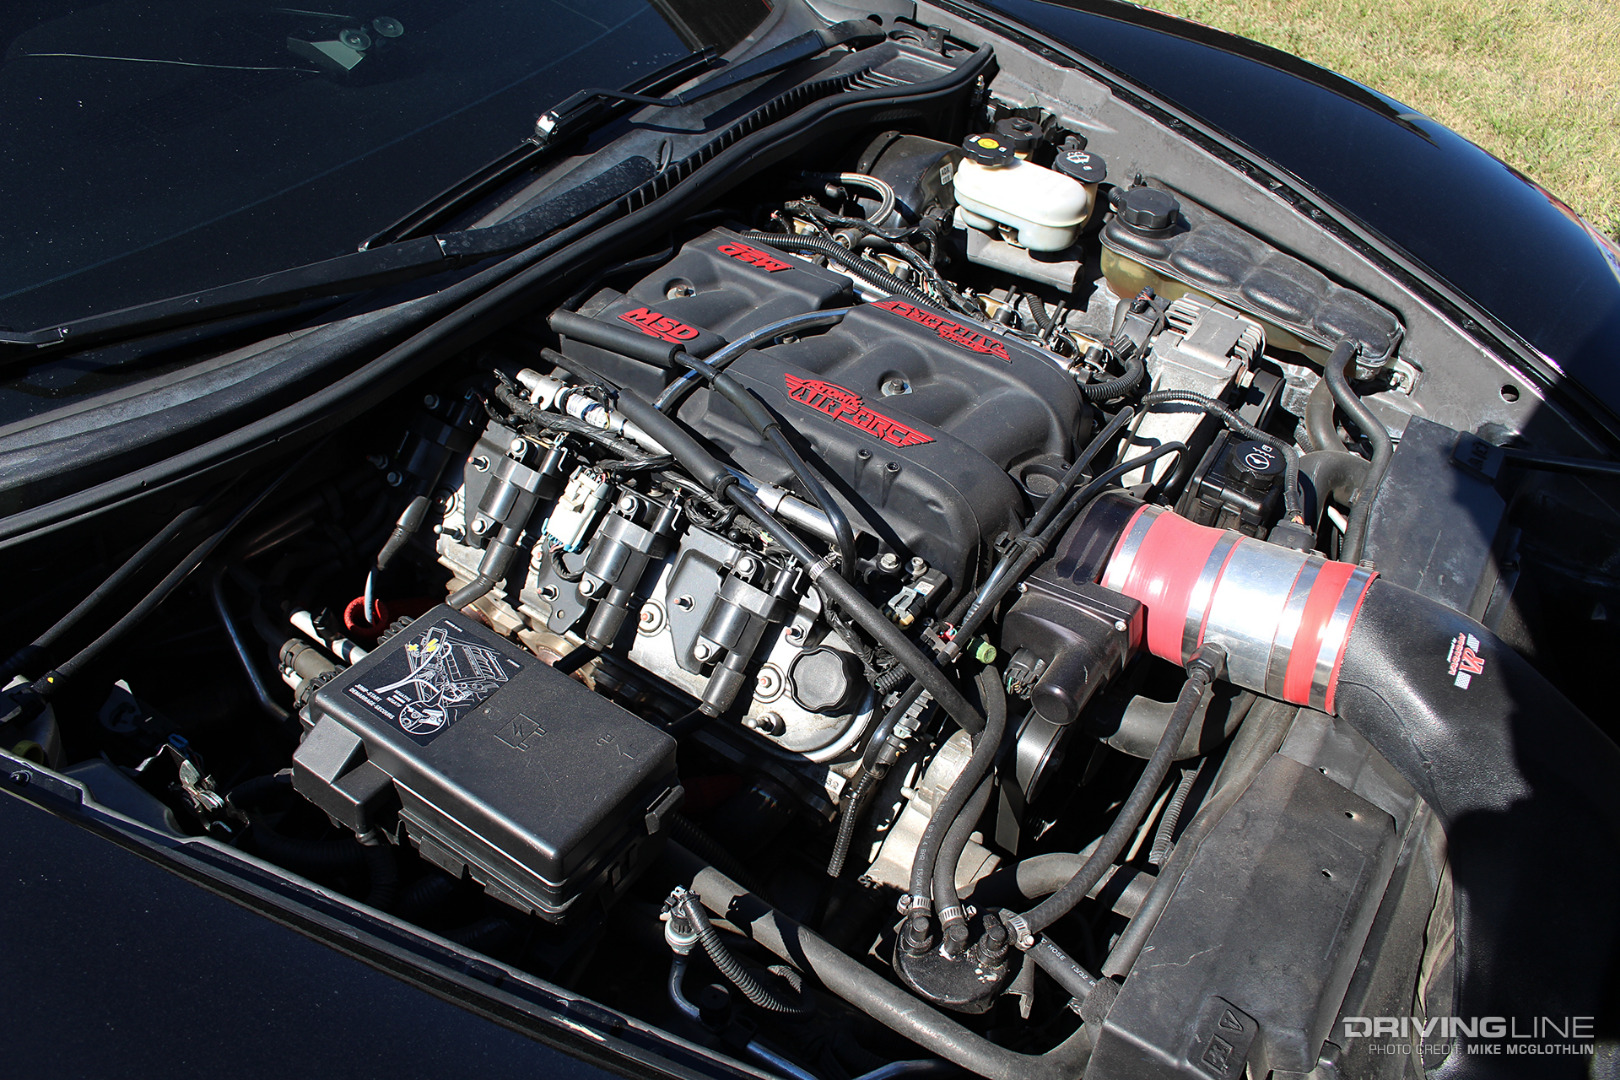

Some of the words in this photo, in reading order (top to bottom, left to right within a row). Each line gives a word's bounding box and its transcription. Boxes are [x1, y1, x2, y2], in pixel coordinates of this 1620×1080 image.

[717, 243, 794, 273] MSD
[624, 307, 700, 340] MSD
[802, 380, 864, 409] ATOMIC
[1459, 647, 1485, 675] VR
[354, 683, 383, 703] JUMP-START
[1047, 944, 1067, 961] HOSE
[1071, 964, 1089, 980] 13/32
